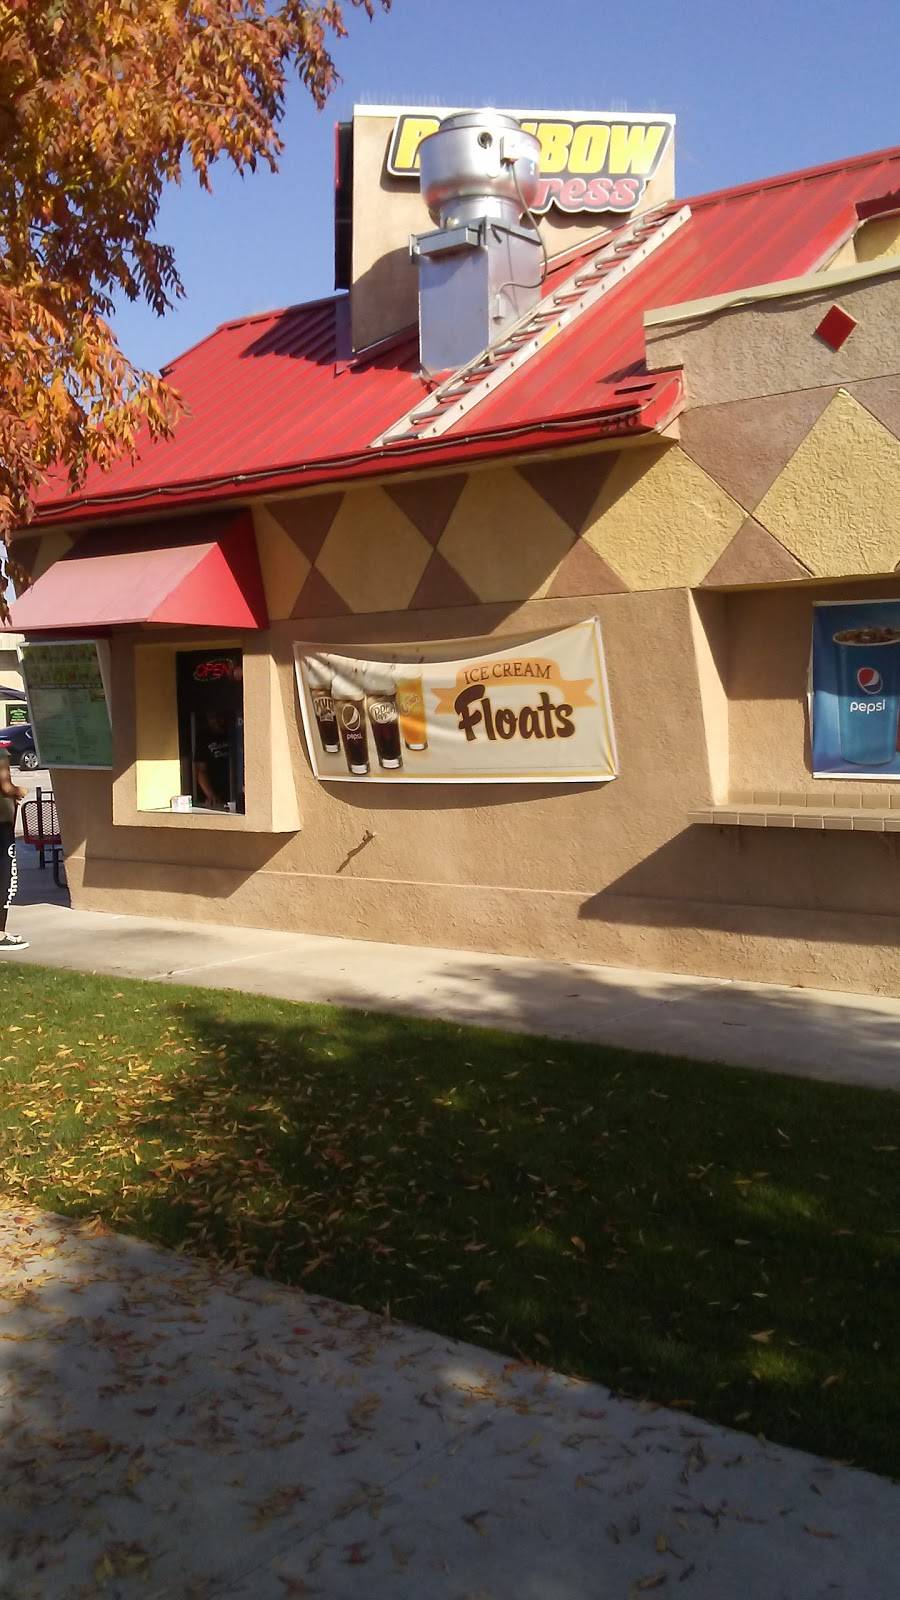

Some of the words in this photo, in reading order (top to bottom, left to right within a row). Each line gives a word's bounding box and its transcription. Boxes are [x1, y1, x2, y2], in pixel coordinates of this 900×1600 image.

[394, 118, 666, 174] RBOW
[534, 178, 639, 207] ress
[463, 663, 489, 684] ICE
[491, 661, 552, 681] CREAM
[454, 684, 576, 742] Floats
[850, 699, 886, 714] pepsi
